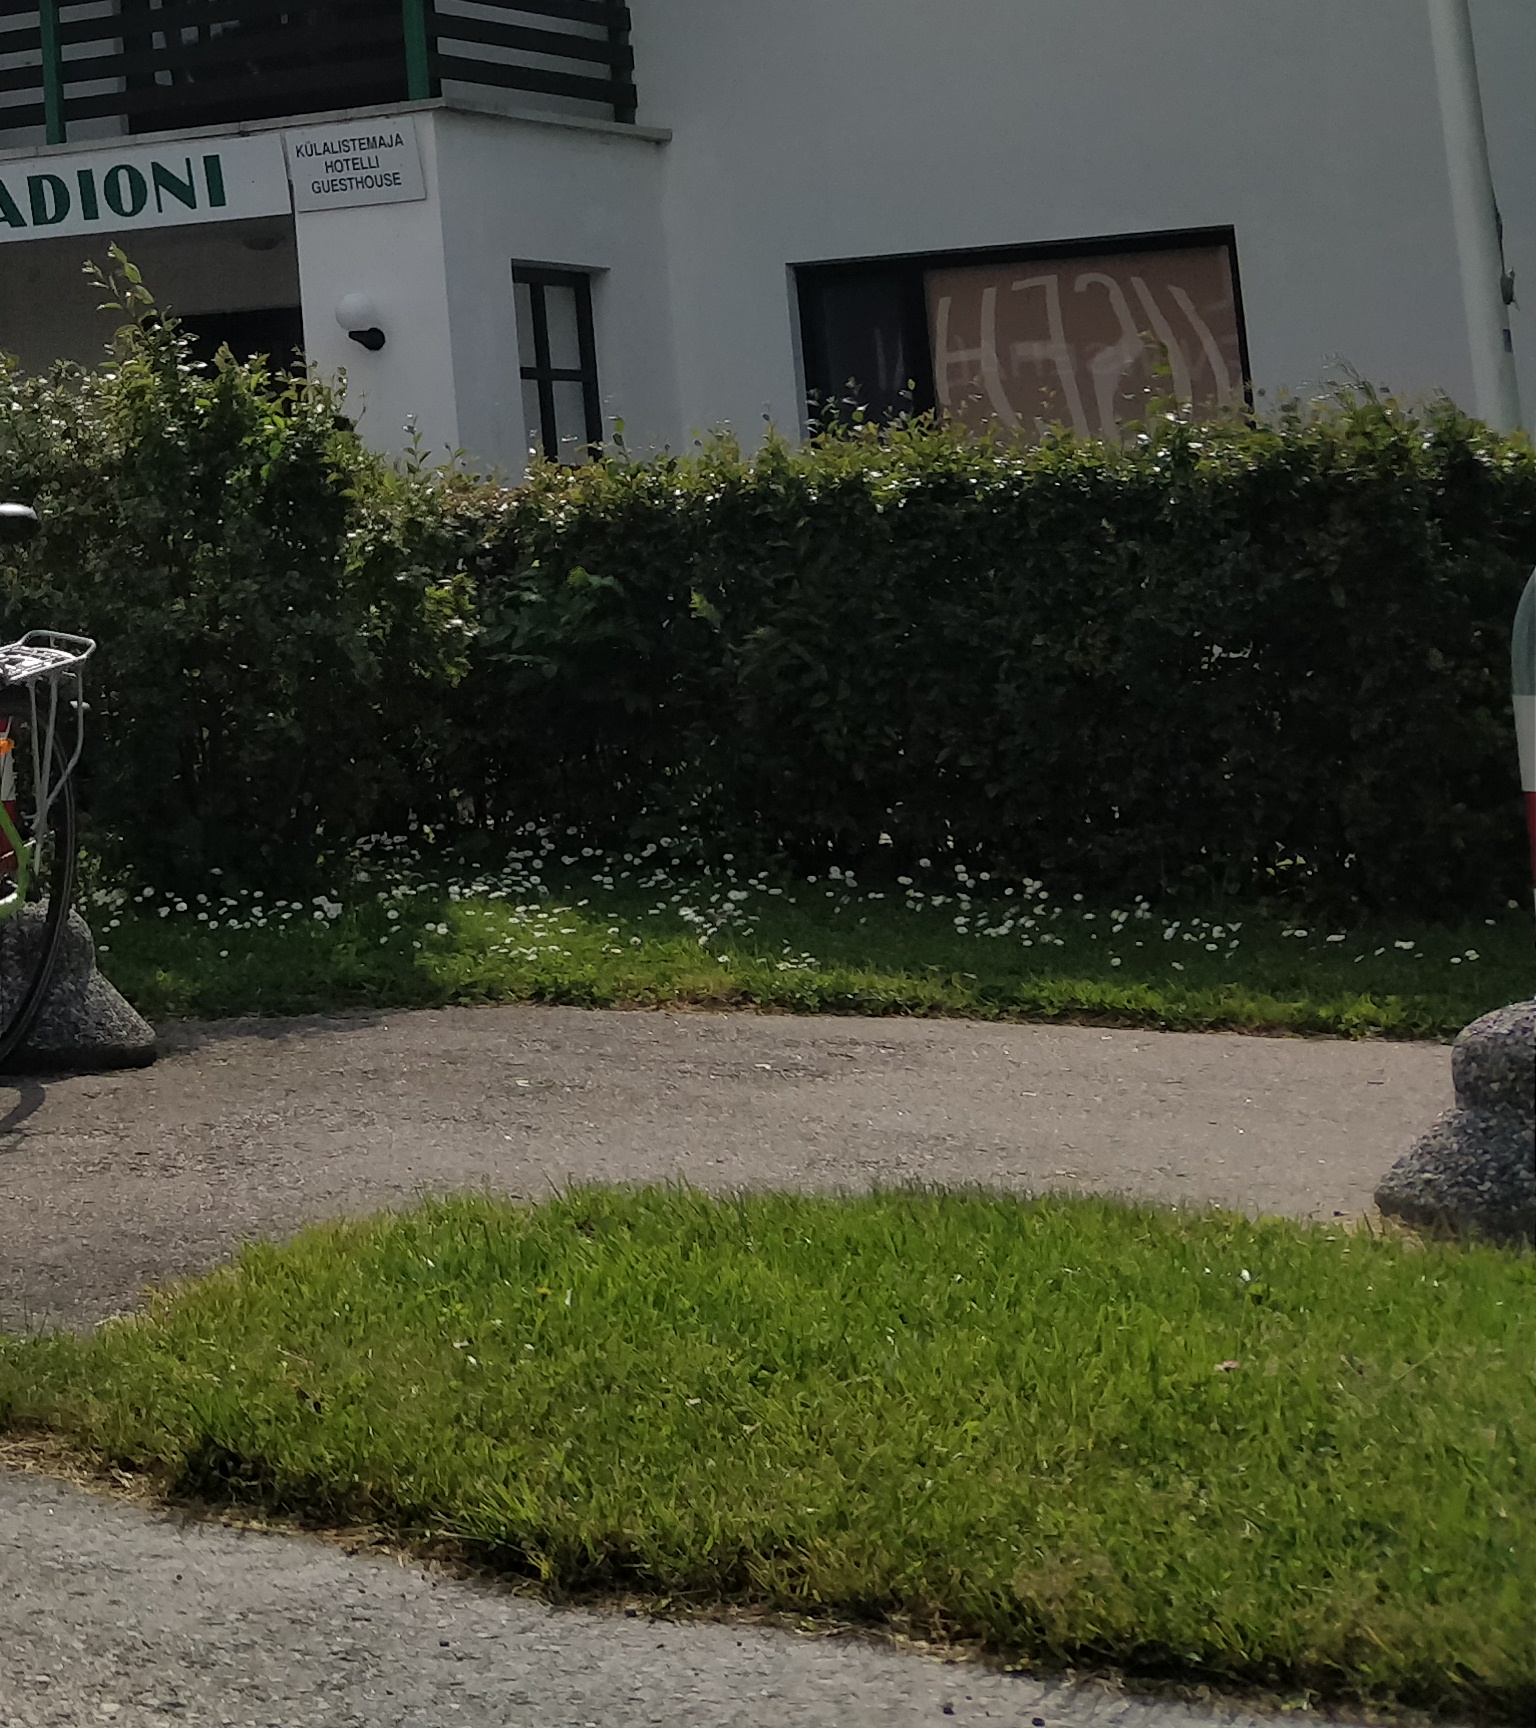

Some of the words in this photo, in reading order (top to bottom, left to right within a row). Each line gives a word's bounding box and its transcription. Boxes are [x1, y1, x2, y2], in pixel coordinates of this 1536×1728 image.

[295, 133, 404, 158] KÜLALISTEMAJA
[324, 155, 380, 174] HOTELLI
[311, 172, 402, 194] GUESTHOUSE
